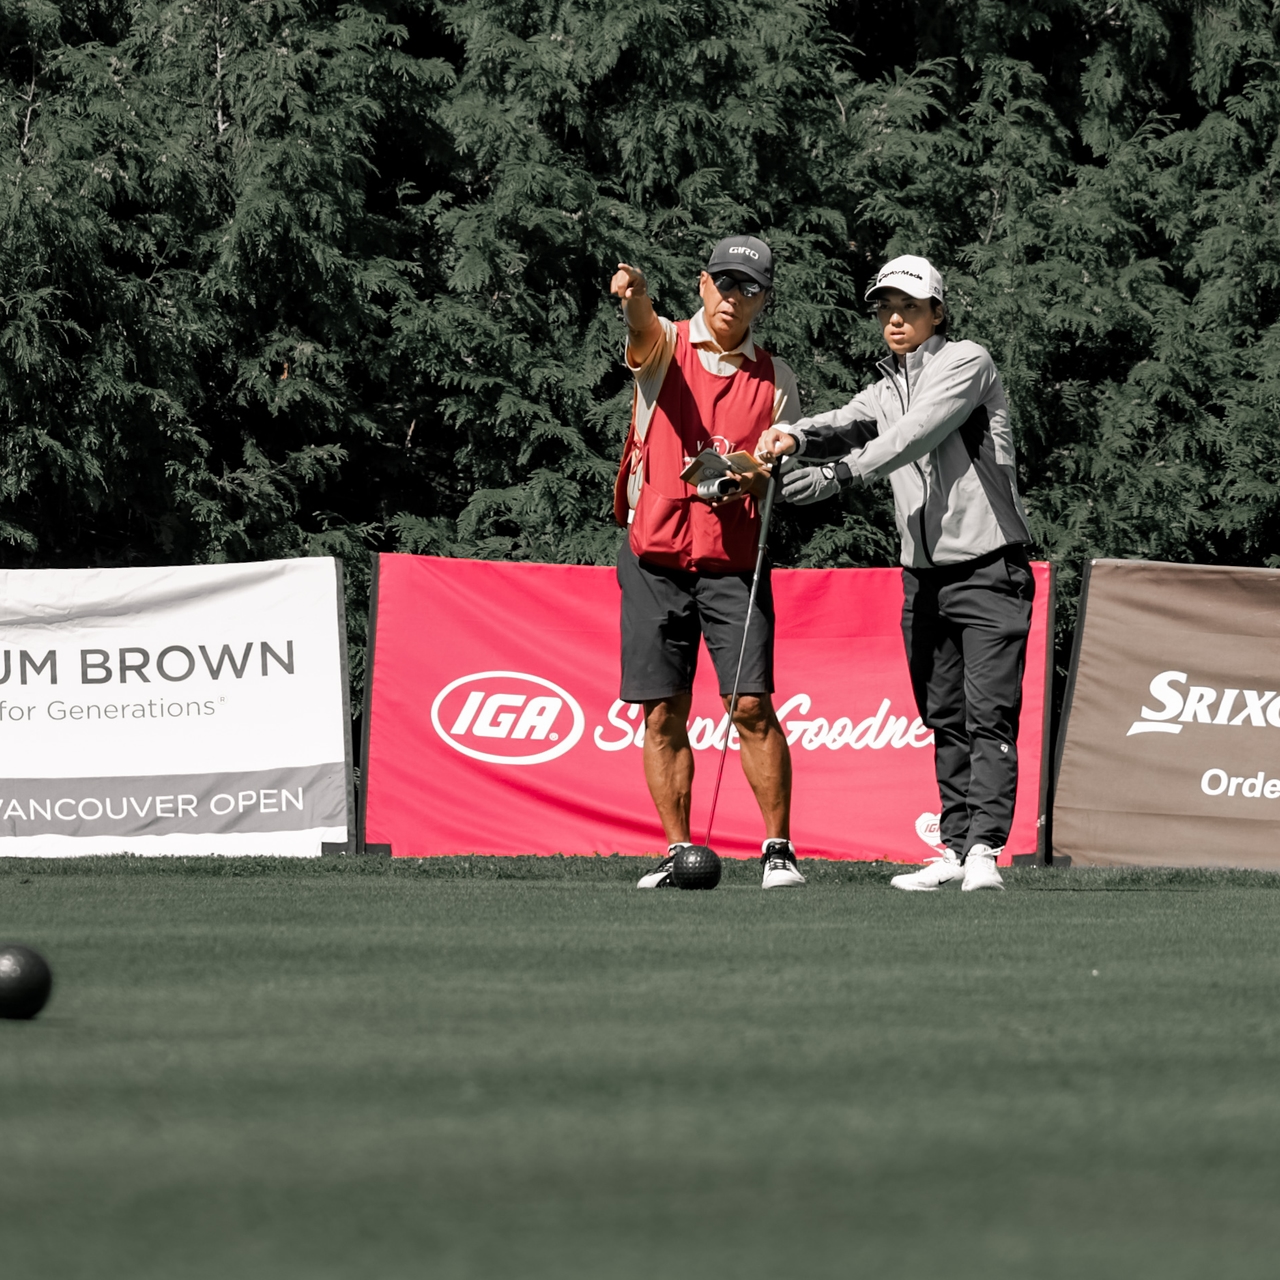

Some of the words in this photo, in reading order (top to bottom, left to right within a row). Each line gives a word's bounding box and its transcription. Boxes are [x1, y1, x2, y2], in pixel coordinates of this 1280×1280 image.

[728, 246, 759, 260] GIRO
[80, 640, 295, 685] BROWN
[46, 697, 217, 721] Generations
[450, 691, 563, 741] IGA
[593, 698, 742, 751] Sple
[775, 693, 935, 751] Goodne
[209, 787, 304, 816] OPEN
